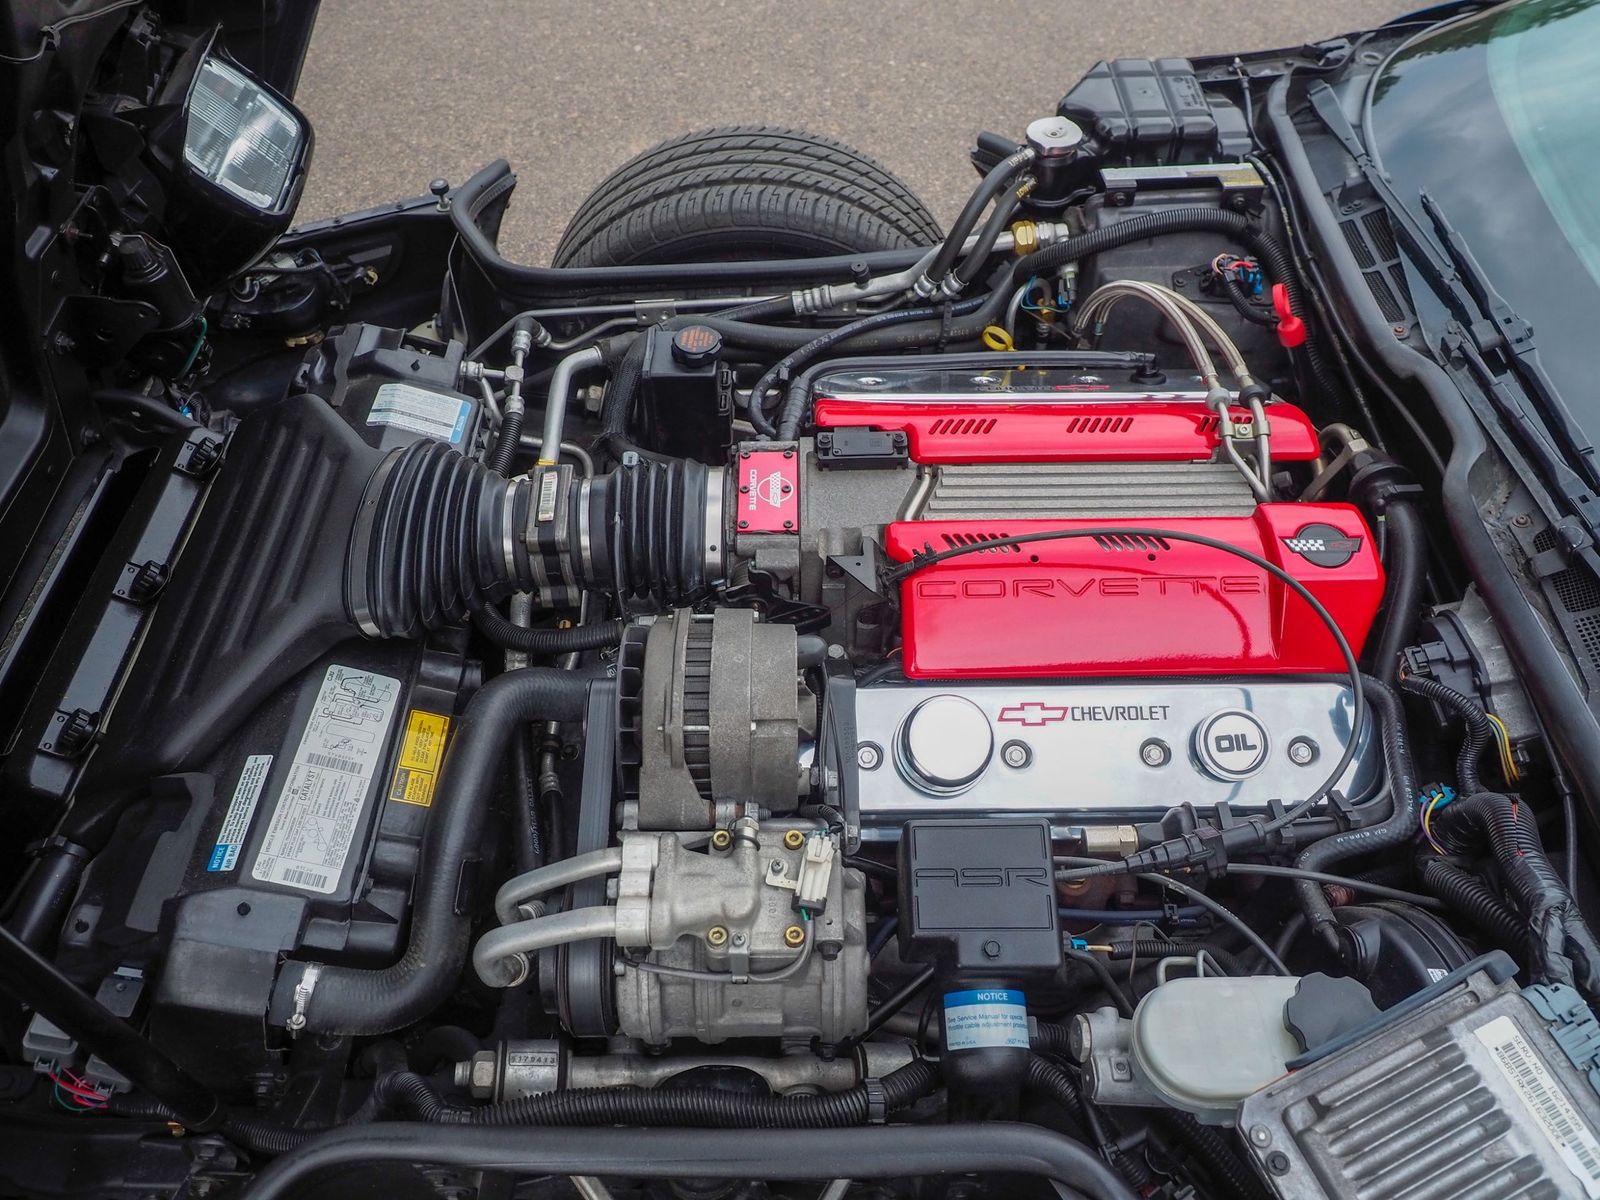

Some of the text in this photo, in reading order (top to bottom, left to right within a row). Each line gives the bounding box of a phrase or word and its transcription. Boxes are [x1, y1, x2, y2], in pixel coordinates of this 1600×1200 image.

[749, 469, 757, 511] CORVETTE
[916, 575, 1261, 600] CORVETTE
[1071, 705, 1170, 721] CHEVROLET
[1215, 734, 1257, 753] OIL
[298, 769, 316, 801] CATALYST
[395, 771, 406, 796] CAUTION
[211, 847, 225, 868] NOTICE
[223, 845, 238, 868] AIR BAG
[914, 867, 1049, 888] ASR
[977, 992, 1008, 1001] NOTICE
